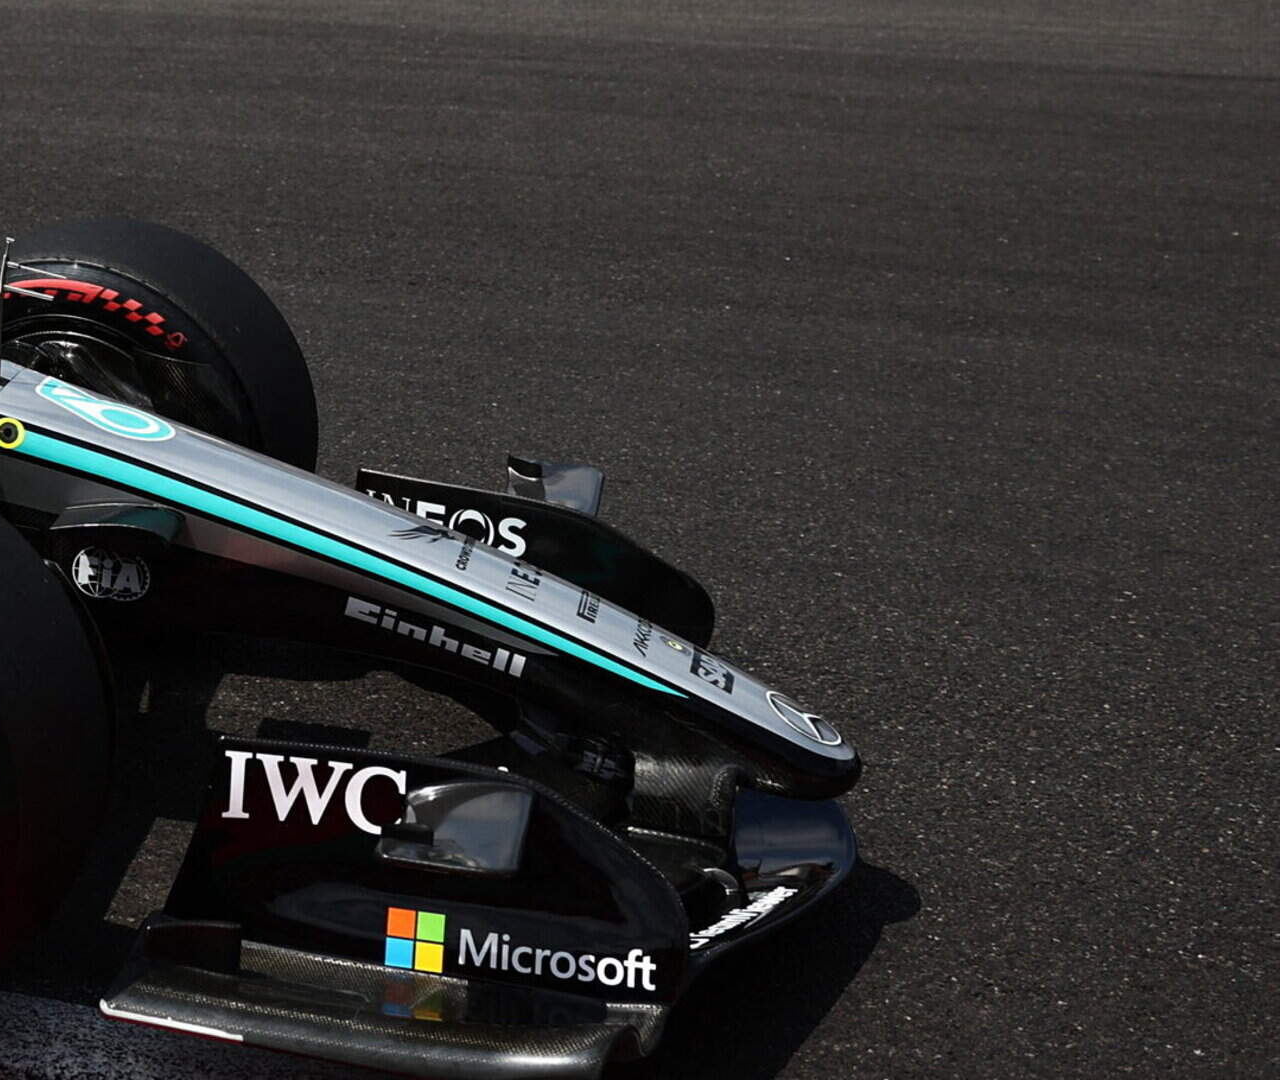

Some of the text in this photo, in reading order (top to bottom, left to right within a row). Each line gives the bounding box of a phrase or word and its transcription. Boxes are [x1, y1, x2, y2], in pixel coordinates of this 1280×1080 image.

[344, 596, 527, 678] Einhell
[221, 749, 407, 835] IWC
[458, 928, 657, 991] Microsoft
